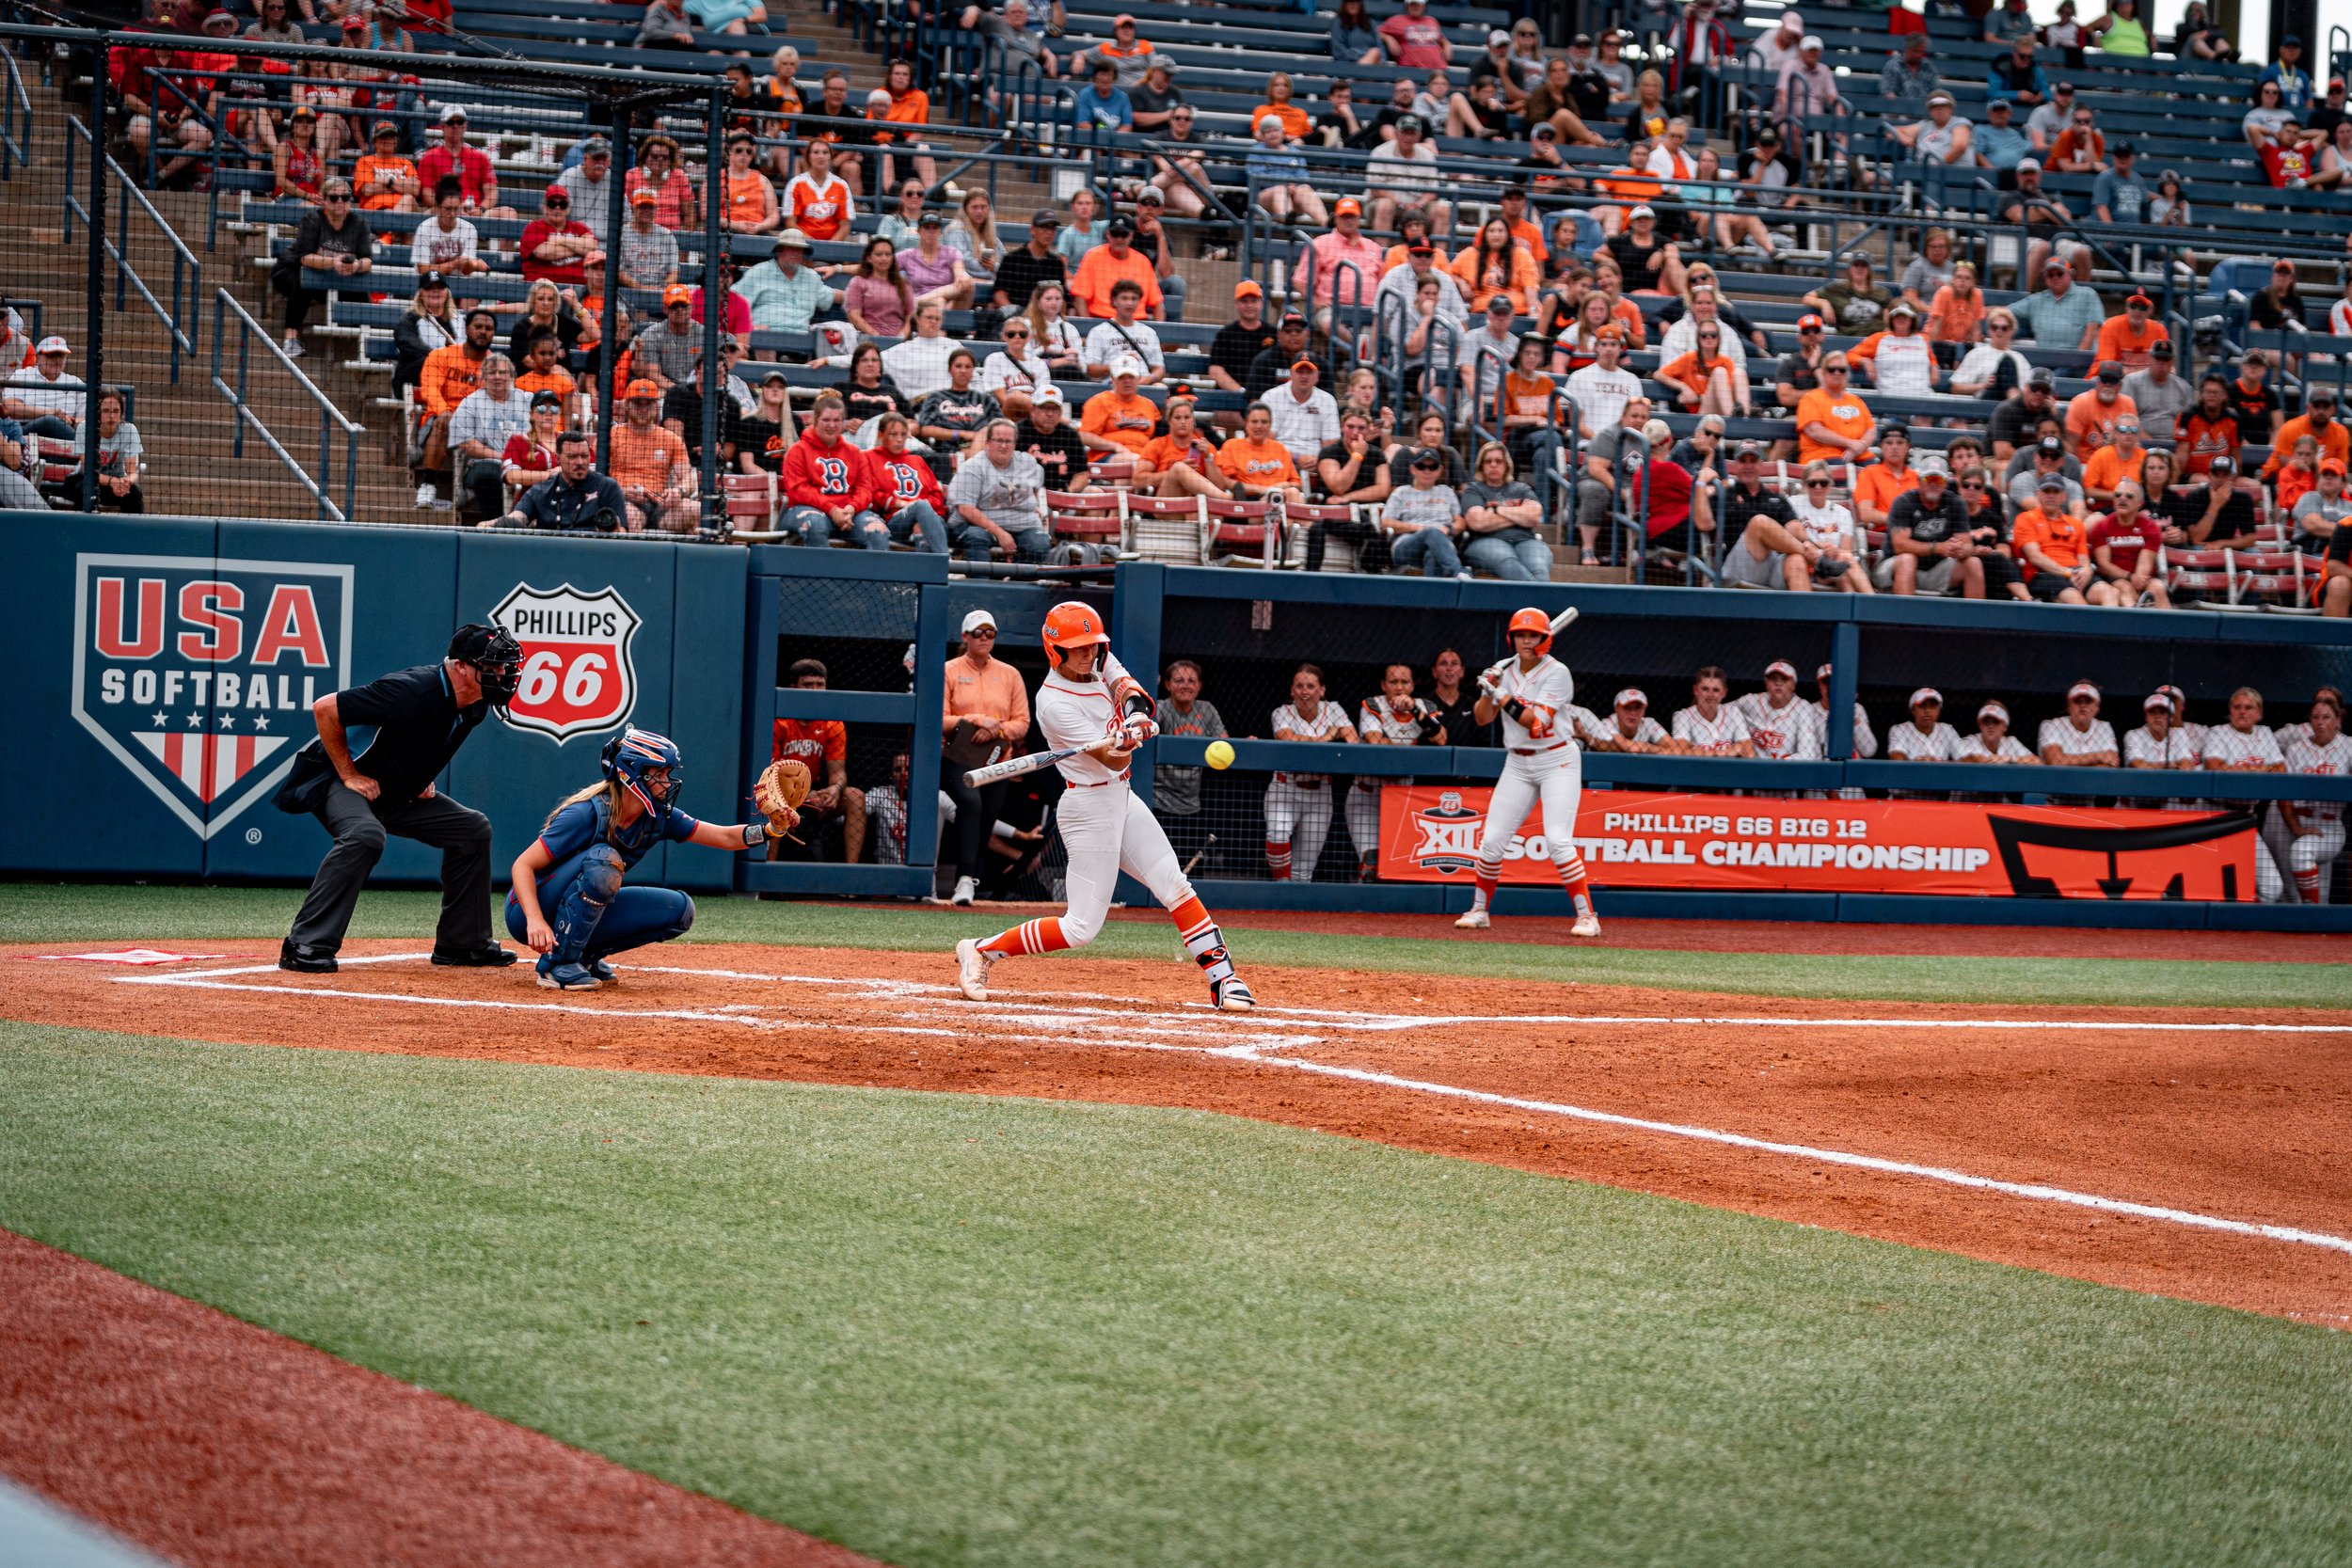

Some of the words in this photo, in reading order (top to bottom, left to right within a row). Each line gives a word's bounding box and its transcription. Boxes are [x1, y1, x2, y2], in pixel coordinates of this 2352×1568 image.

[815, 457, 850, 495] B
[883, 462, 923, 499] B
[95, 577, 330, 667] USA
[515, 609, 617, 637] PHILLIPS
[1083, 620, 1091, 633] 5
[101, 668, 314, 709] SOFTBALL
[517, 650, 608, 707] 66
[1416, 817, 1484, 858] XII
[1604, 813, 1729, 834] PHILLIPS
[1736, 816, 1773, 836] 66
[1779, 817, 1829, 838] BIG
[1836, 819, 1867, 838] 12
[1502, 834, 1695, 864] SOTBALL
[1701, 840, 1990, 873] CHAMPIONSHIP
